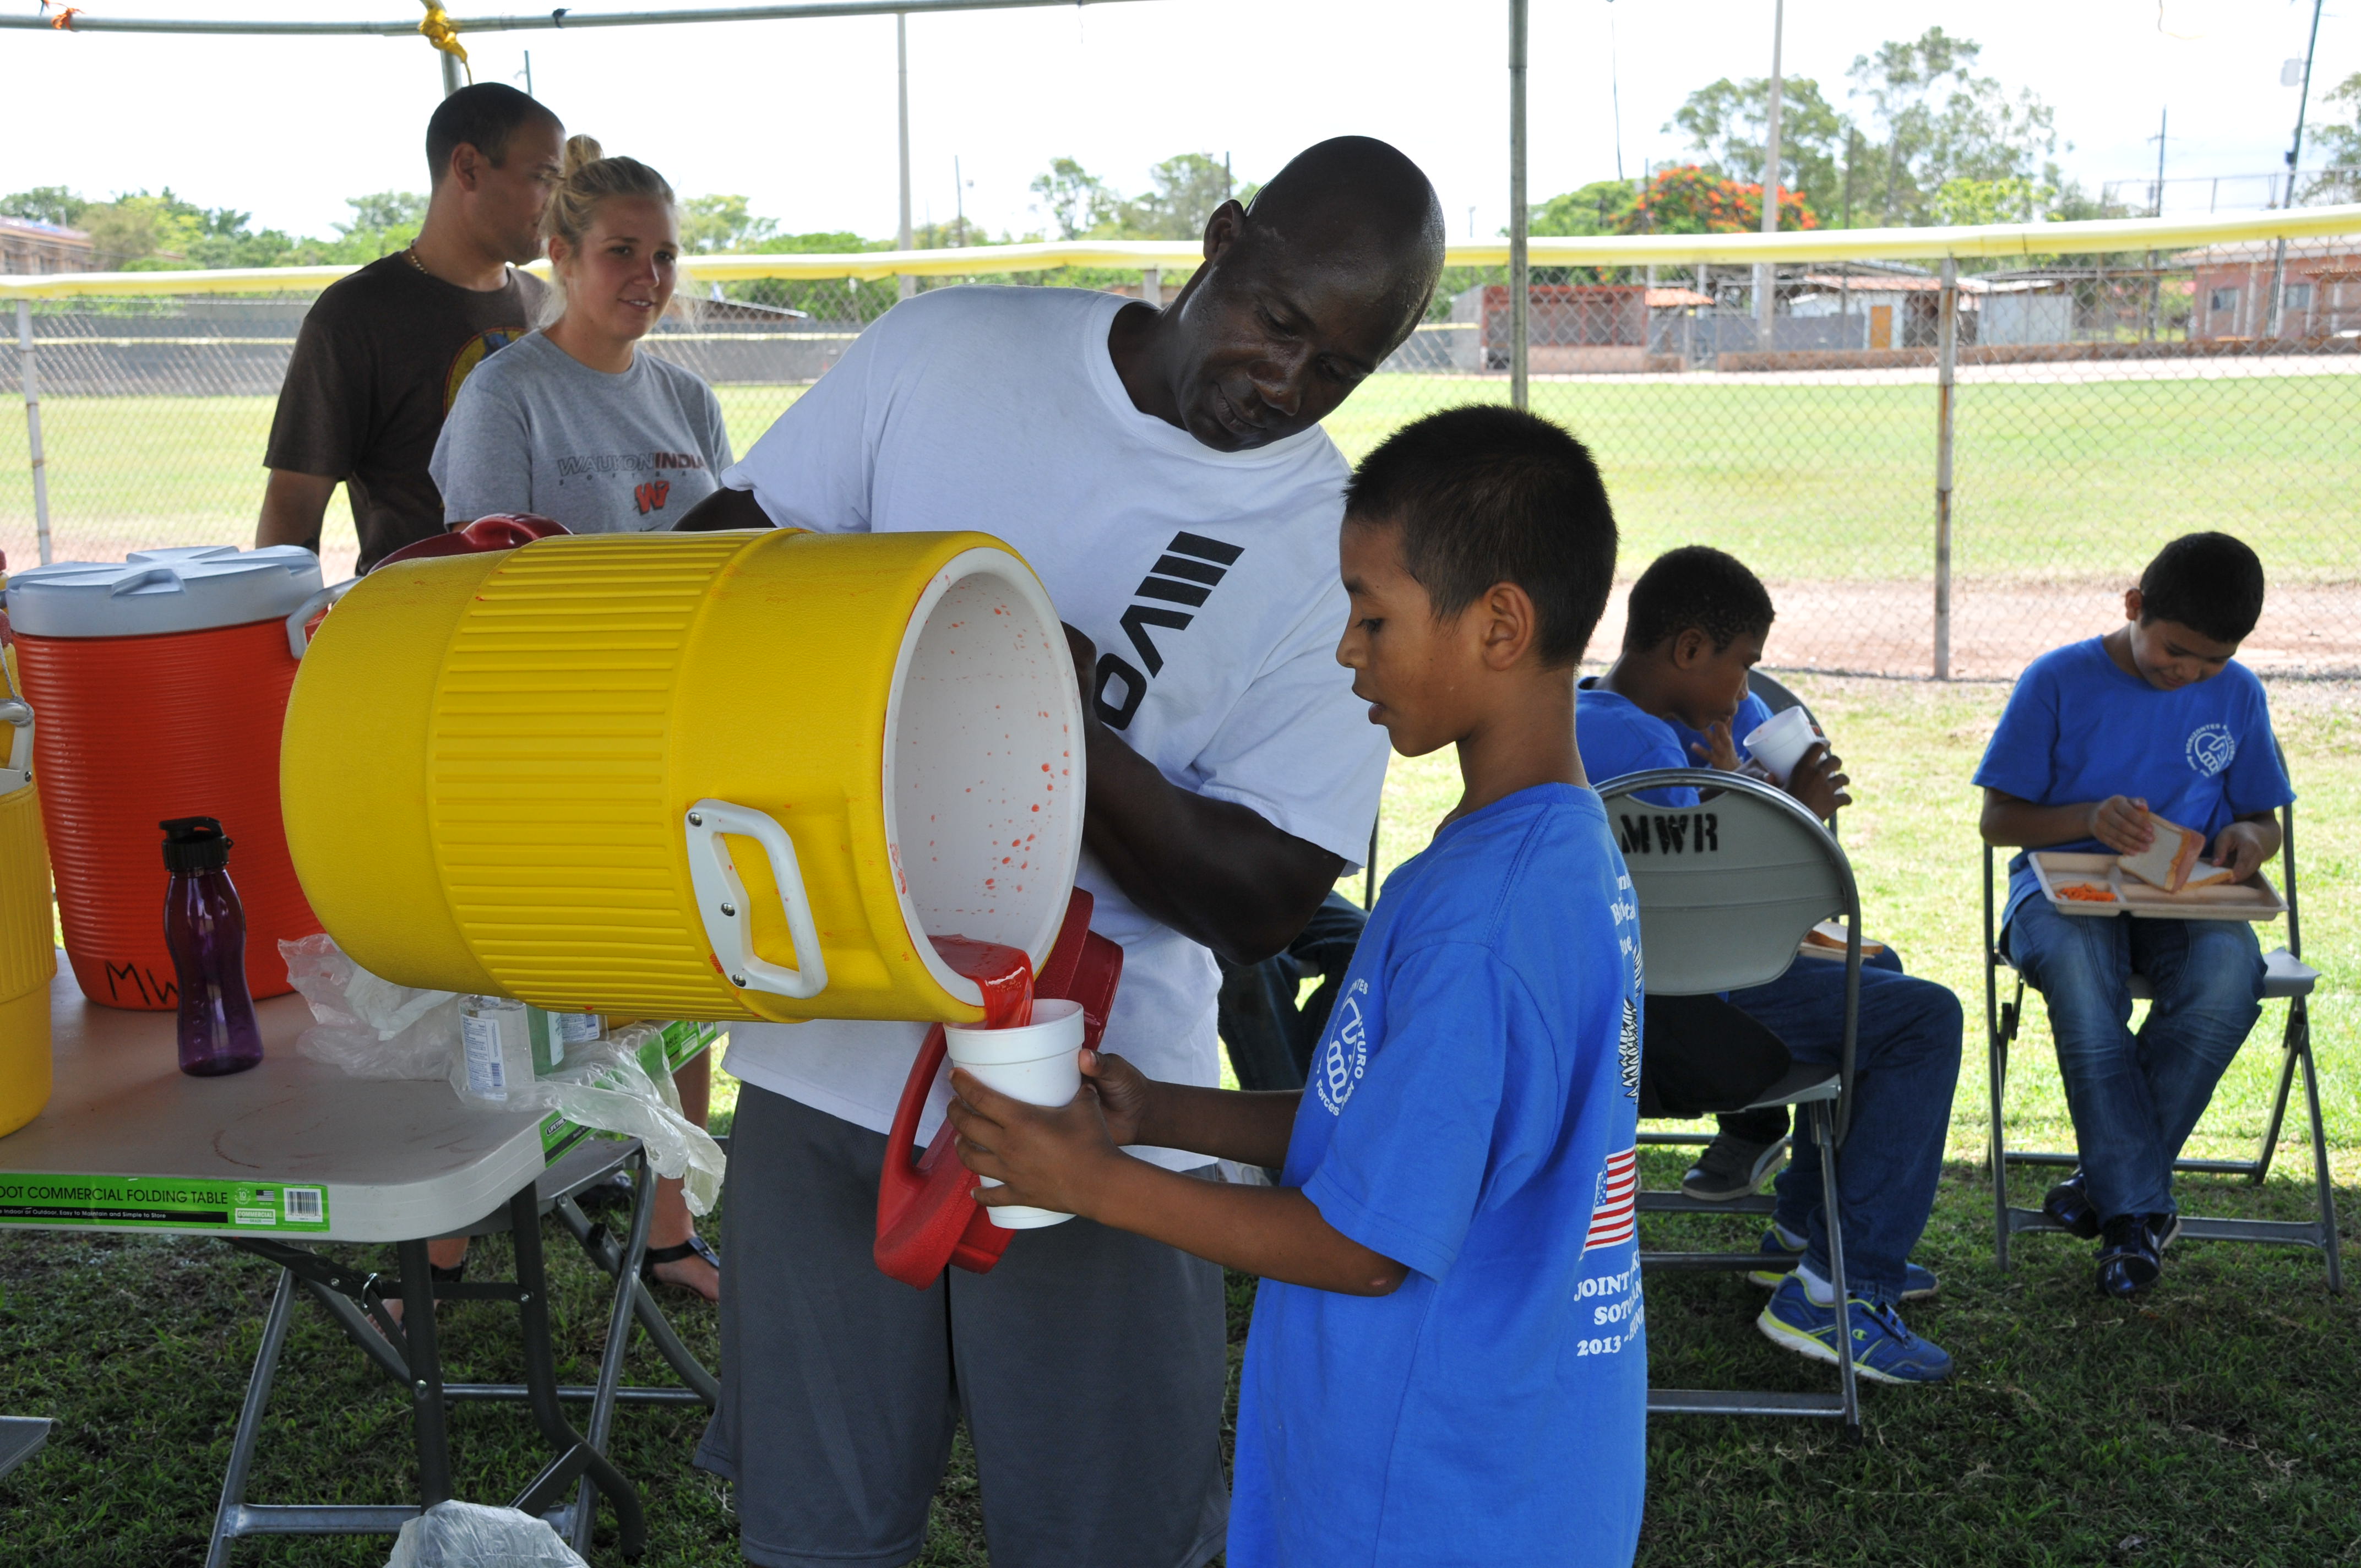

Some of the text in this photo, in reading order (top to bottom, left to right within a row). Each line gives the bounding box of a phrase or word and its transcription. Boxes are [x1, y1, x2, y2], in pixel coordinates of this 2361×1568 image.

[1620, 813, 1718, 854] MWR
[1316, 1079, 1340, 1116] Forces
[28, 1186, 123, 1201] COMMERCIAL
[127, 1189, 188, 1203] FOLDING
[191, 1191, 228, 1205] TABLE
[1573, 1271, 1630, 1302] JOINT
[1576, 1335, 1622, 1357] 2013
